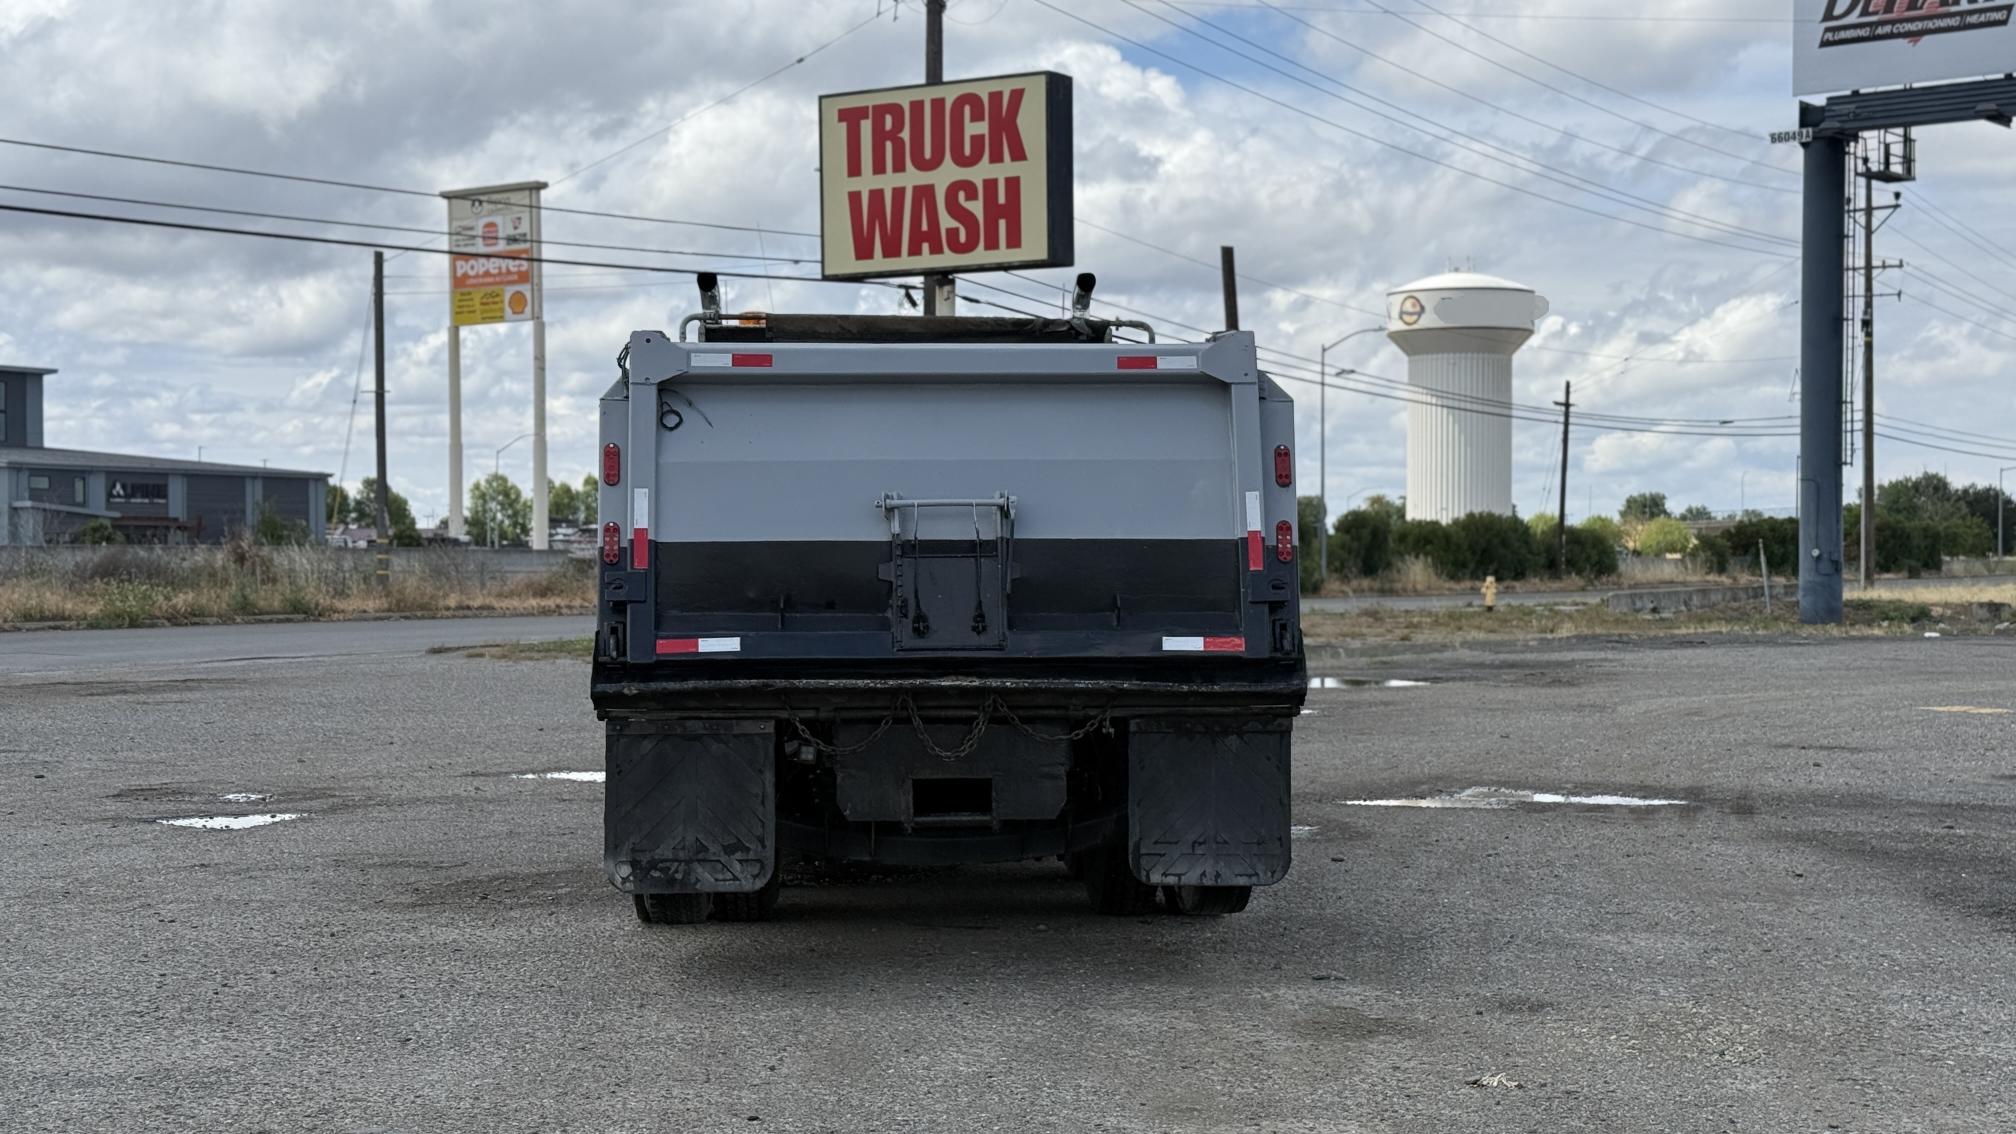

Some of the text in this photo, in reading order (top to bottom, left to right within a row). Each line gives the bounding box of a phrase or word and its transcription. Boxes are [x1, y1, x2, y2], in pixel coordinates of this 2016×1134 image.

[1874, 24, 1892, 35] AIR
[1893, 16, 1960, 33] CONDITIONING
[1965, 10, 2007, 25] HEATING
[837, 88, 1028, 178] TRUCK
[847, 175, 1022, 261] WASH
